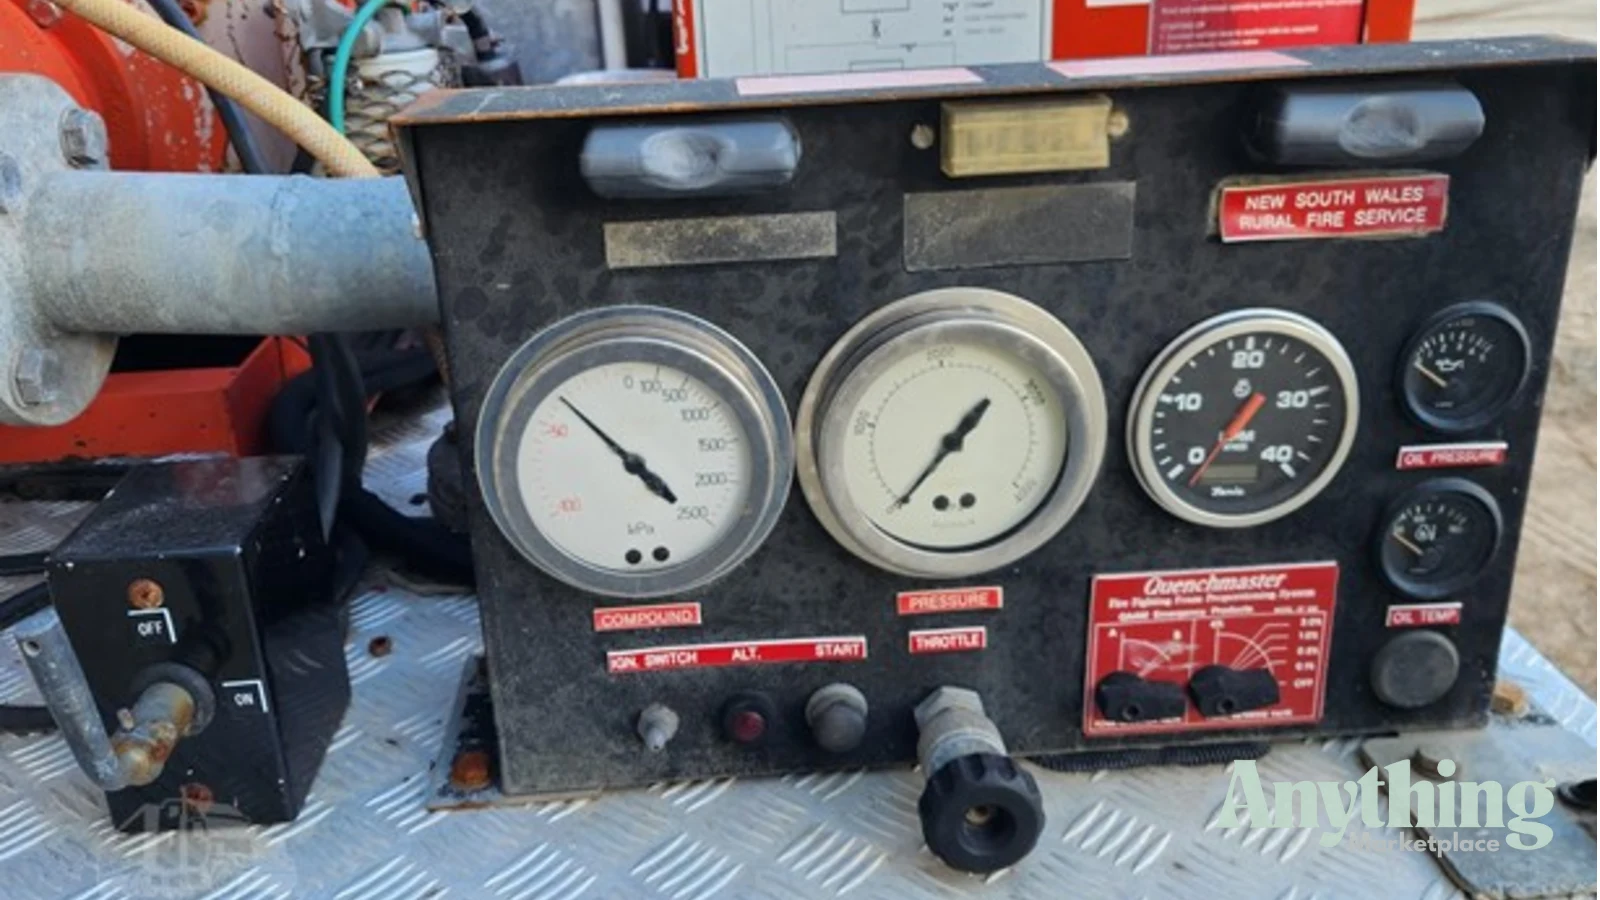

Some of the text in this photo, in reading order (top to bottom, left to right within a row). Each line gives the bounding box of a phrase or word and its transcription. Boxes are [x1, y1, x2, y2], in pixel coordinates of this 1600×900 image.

[1245, 187, 1424, 210] NEW SOUTH WALES
[1239, 207, 1428, 231] RURAL FIRE SERVICE
[1232, 350, 1265, 368] 20
[622, 375, 634, 390] 0
[662, 387, 688, 403] 500
[1174, 392, 1202, 411] 10
[1276, 390, 1309, 409] 30
[681, 407, 710, 422] 1000
[698, 437, 725, 452] 1500
[1187, 446, 1206, 464] 0
[1260, 445, 1293, 462] 40
[1403, 449, 1498, 465] OIL PRESSURE
[695, 472, 727, 487] 2000
[676, 505, 709, 520] 2500
[1144, 573, 1288, 596] Quenchmaster
[909, 591, 989, 609] PRESSURE
[601, 609, 693, 627] COMPOUND
[1393, 609, 1458, 624] OIL TEMP
[137, 620, 164, 637] OFF
[814, 642, 860, 658] START
[917, 633, 979, 650] THROTTLE
[645, 650, 698, 667] SWITCH
[732, 646, 761, 661] ALT.
[234, 693, 254, 707] ON
